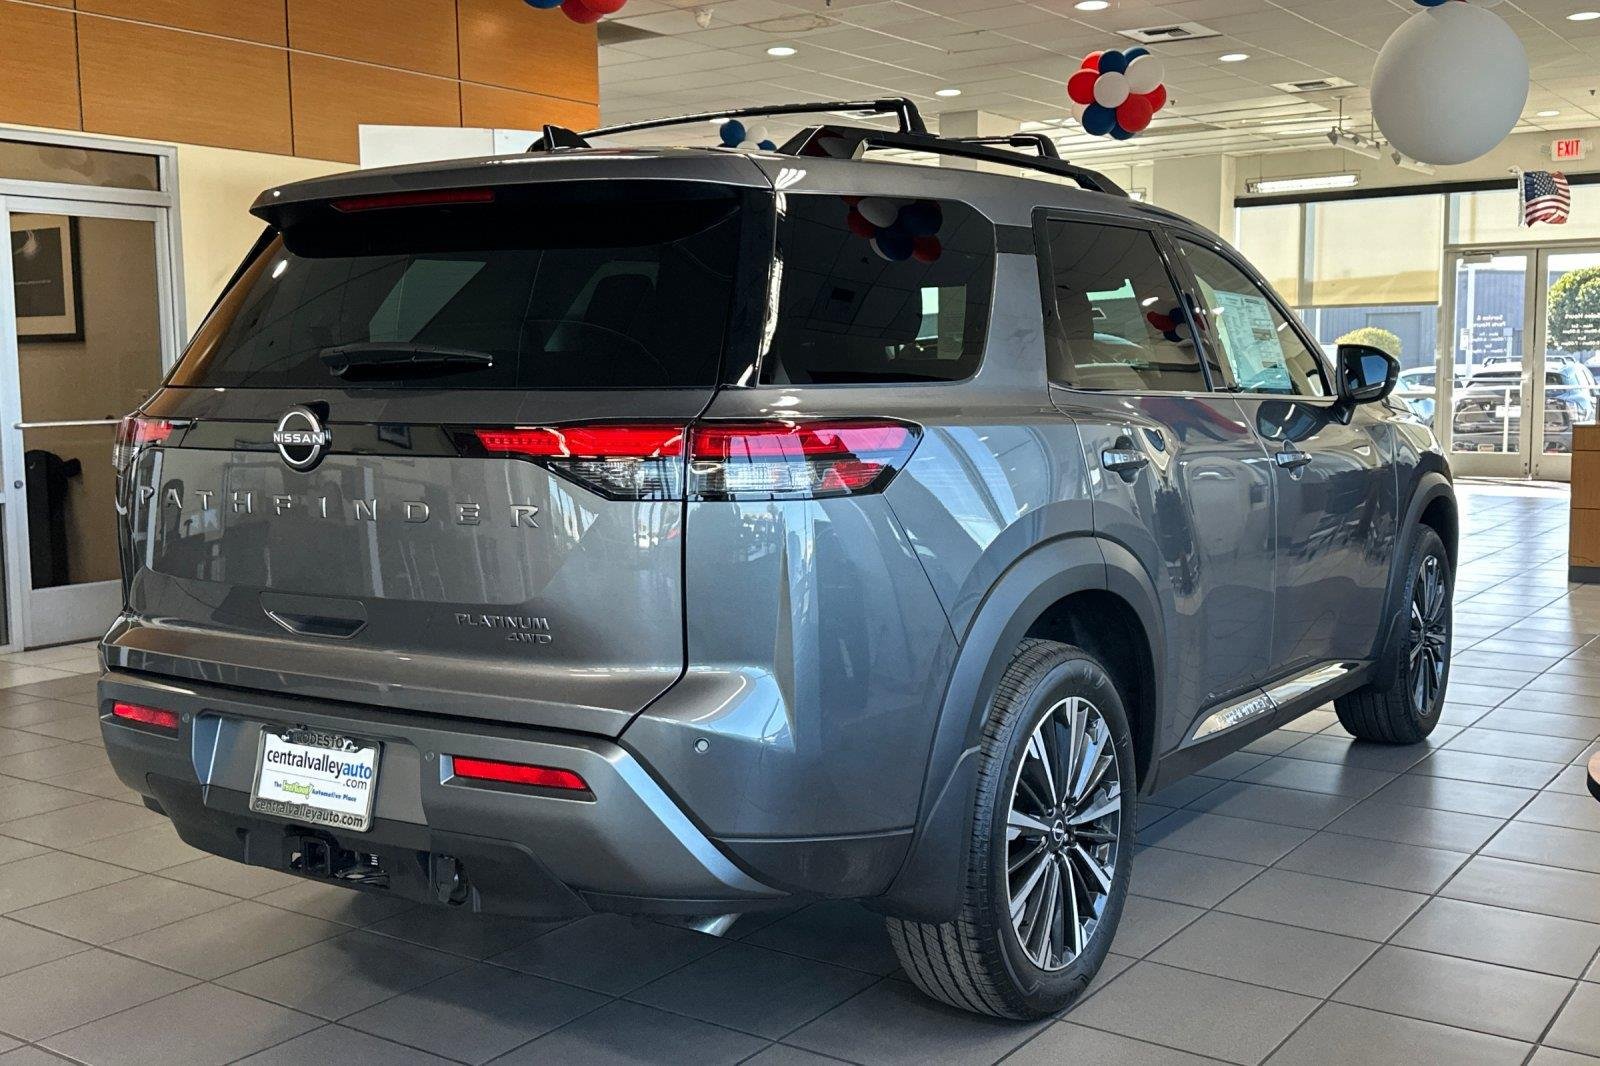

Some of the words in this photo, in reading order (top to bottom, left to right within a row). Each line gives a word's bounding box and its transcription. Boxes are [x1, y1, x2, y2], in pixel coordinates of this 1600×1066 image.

[1557, 140, 1581, 157] EXIT
[273, 432, 324, 444] NISSAN
[140, 485, 541, 529] PATHFINDER
[454, 612, 550, 630] PLATINUM
[266, 750, 373, 779] centralvalleyauto
[254, 799, 363, 828] centralvalleyauto.com
